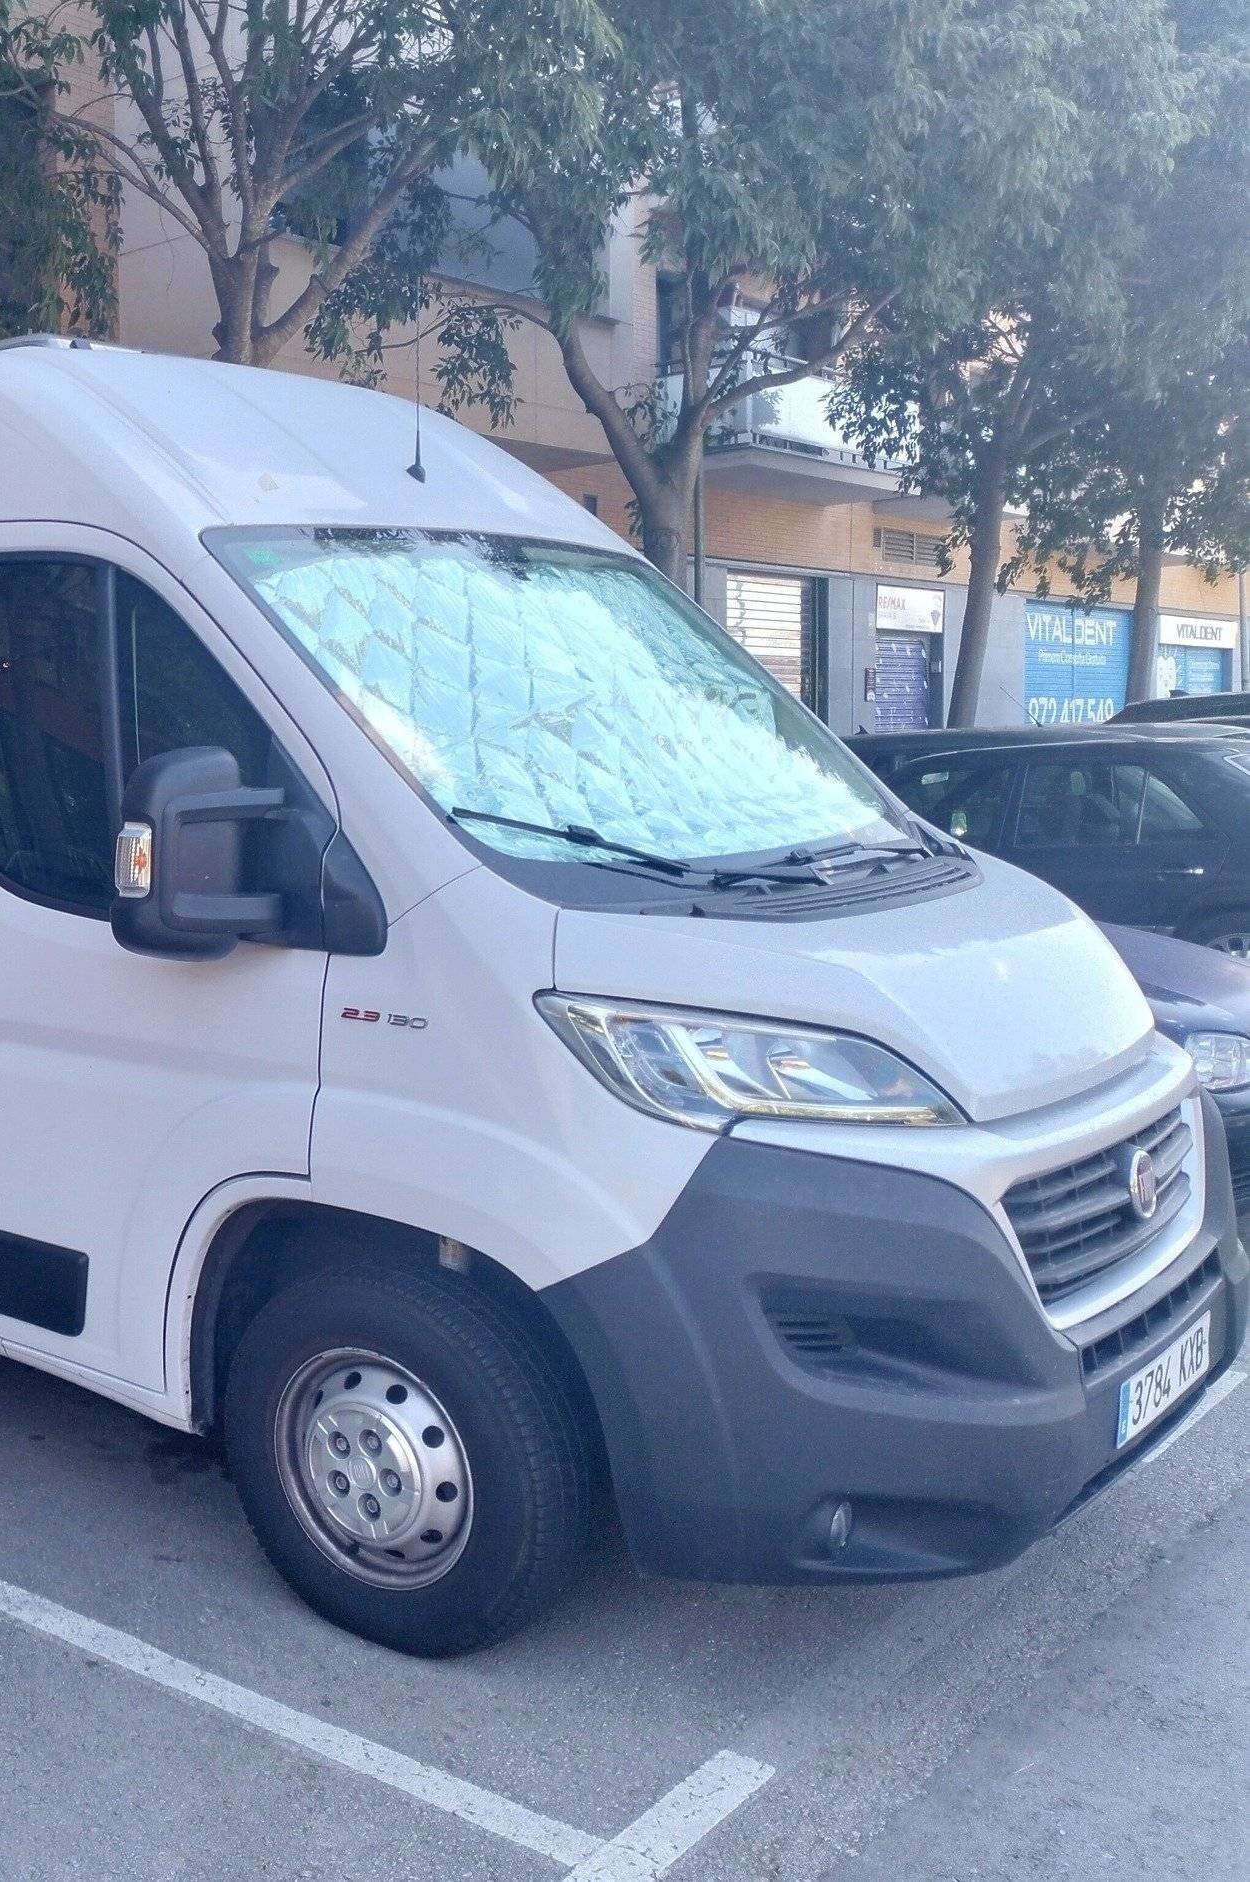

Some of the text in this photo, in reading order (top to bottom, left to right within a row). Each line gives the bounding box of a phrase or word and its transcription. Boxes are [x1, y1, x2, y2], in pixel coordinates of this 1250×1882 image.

[878, 595, 906, 610] RE/MAX
[1026, 611, 1117, 647] VITALDENT
[1176, 624, 1223, 641] VITALDENT
[1029, 697, 1114, 723] 972 417 549
[387, 1013, 428, 1029] 130
[1132, 1326, 1204, 1426] 3784 KXB
